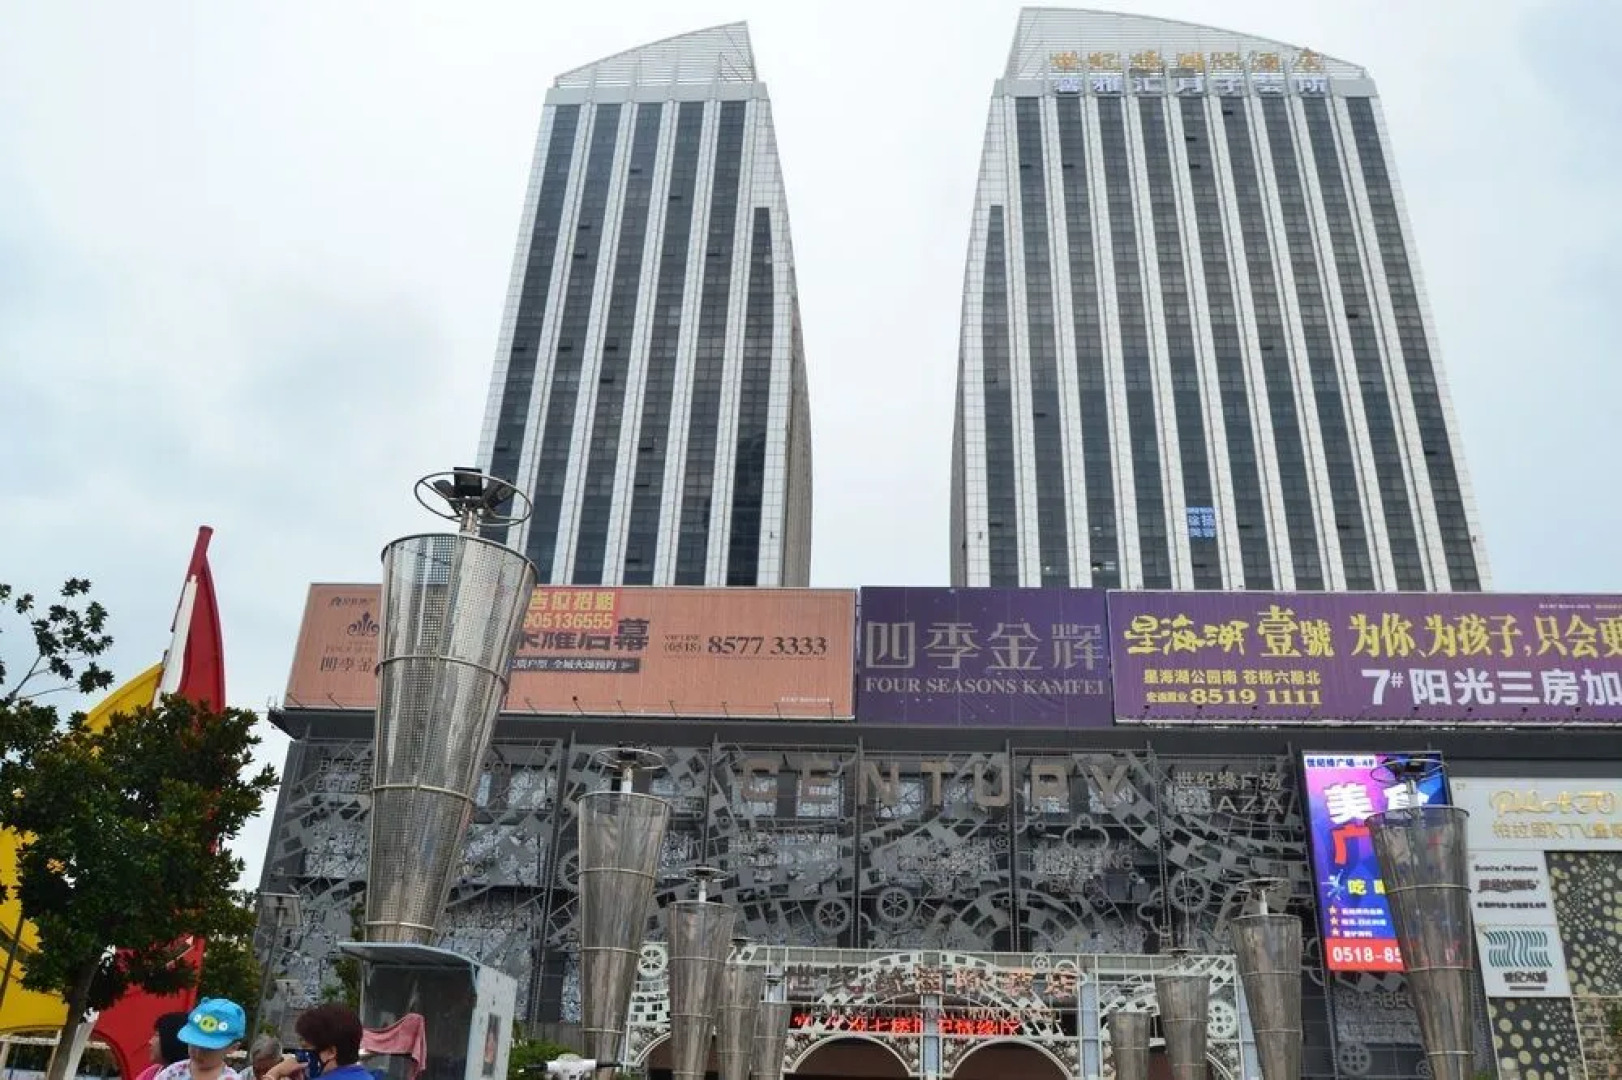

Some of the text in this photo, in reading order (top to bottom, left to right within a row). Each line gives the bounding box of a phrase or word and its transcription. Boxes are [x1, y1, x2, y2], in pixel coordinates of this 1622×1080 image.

[708, 636, 764, 655] 8577
[770, 636, 827, 655] 3333
[865, 621, 1104, 671] 四季金辉
[865, 677, 1104, 695] FOUR SEASONS KAMFEI
[1190, 689, 1257, 704] 8519
[1266, 689, 1322, 704] 1111
